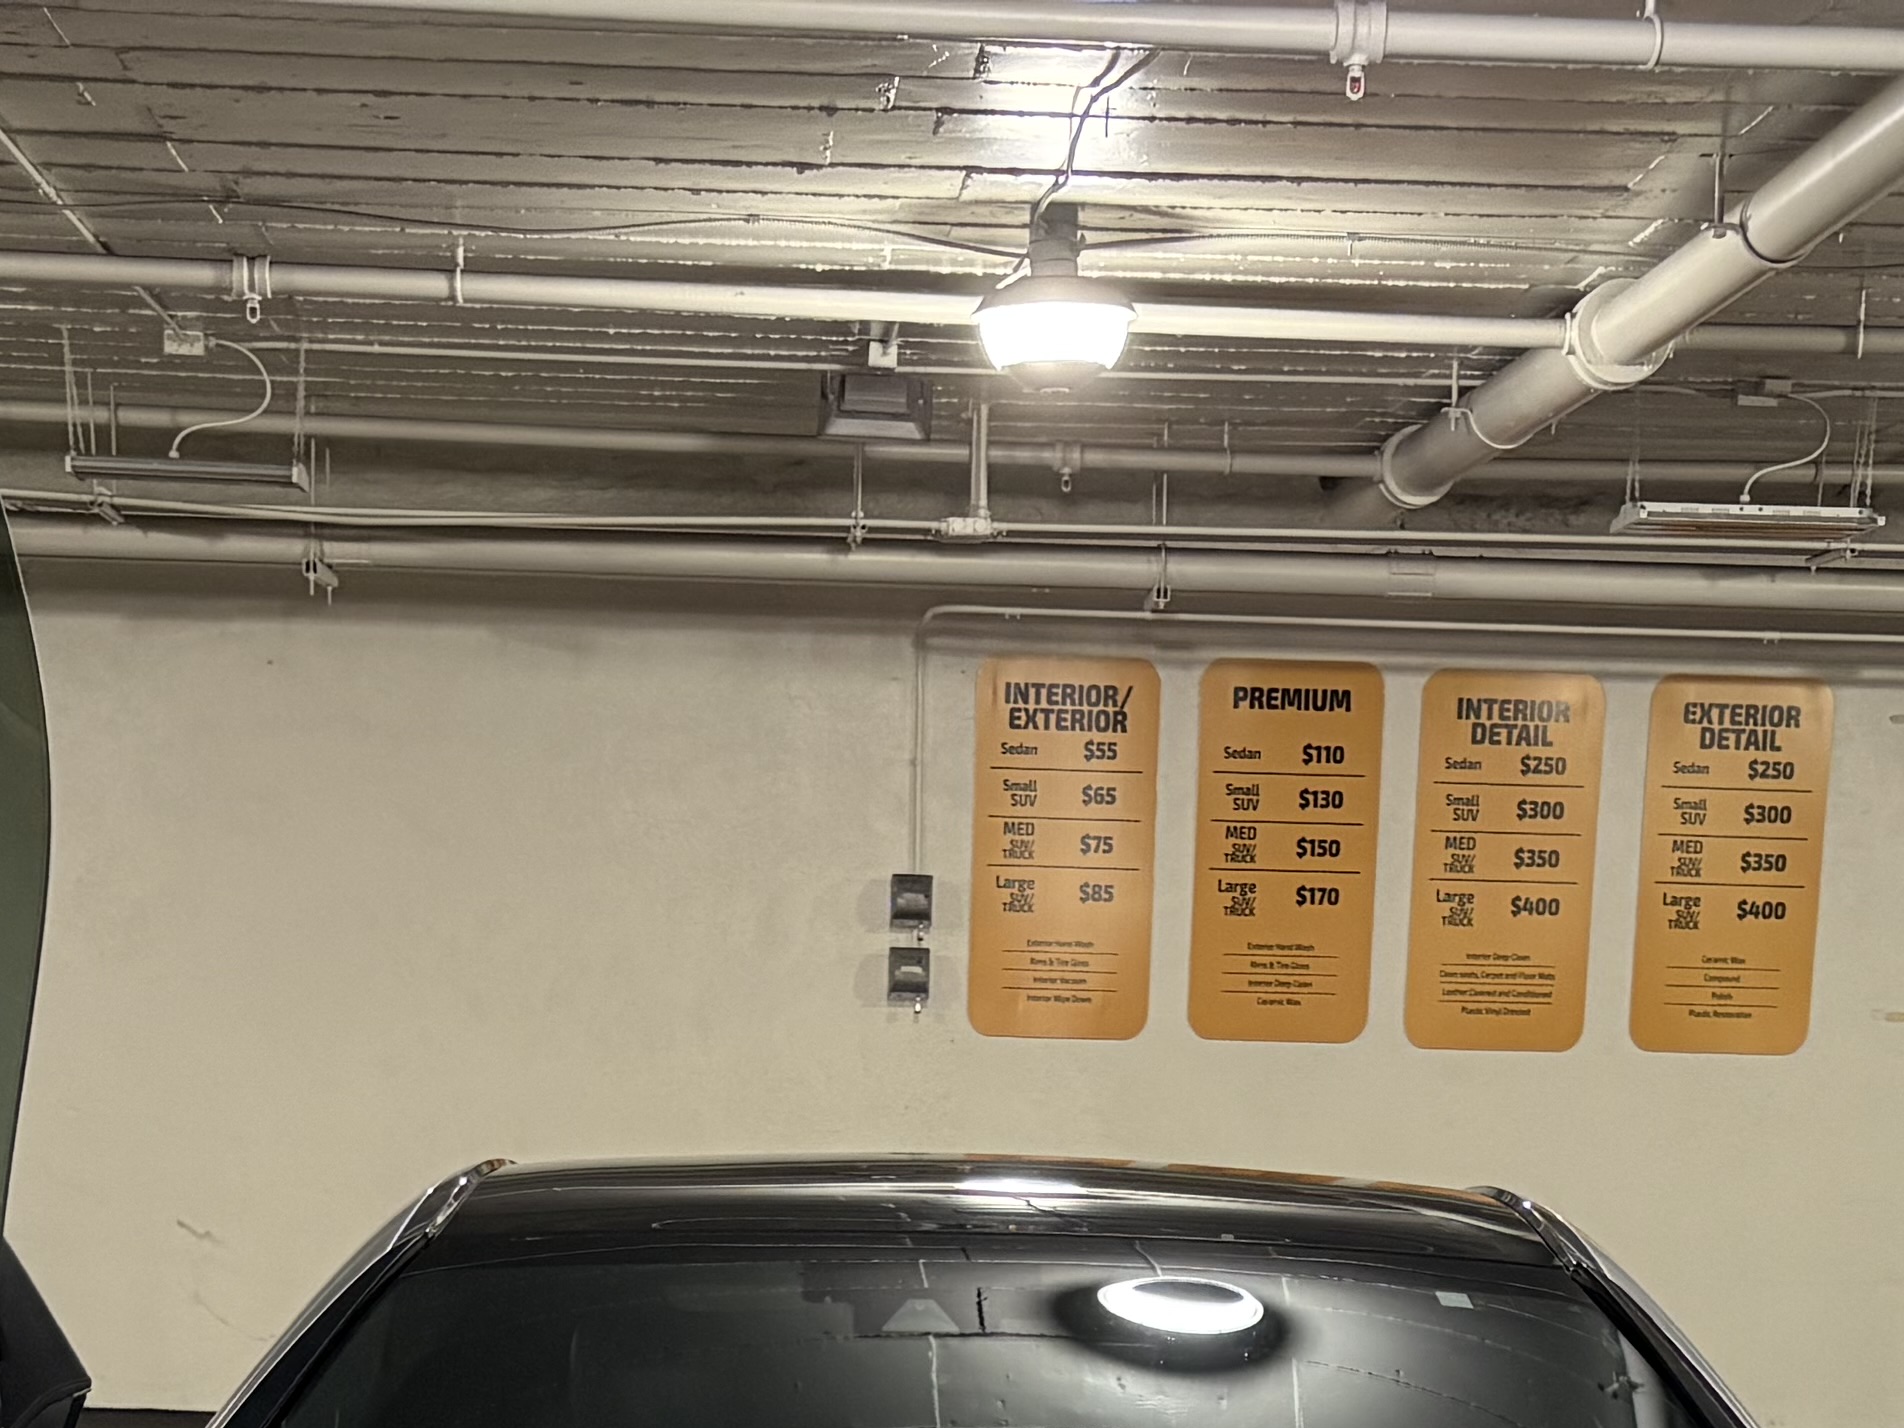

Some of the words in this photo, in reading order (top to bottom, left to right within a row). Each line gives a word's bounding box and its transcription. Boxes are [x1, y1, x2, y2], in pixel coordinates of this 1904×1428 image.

[1004, 682, 1133, 711] INTERIOR/
[1233, 686, 1352, 712] PREMIUM
[1008, 707, 1128, 733] EXTERIOR
[1456, 697, 1571, 723] INTERIOR
[1683, 702, 1801, 728] EXTERIOR
[1471, 722, 1553, 747] DETAIL
[1699, 727, 1782, 752] DETAIL
[1001, 742, 1038, 755] Sedan
[1084, 738, 1118, 762] $55
[1224, 746, 1261, 760] Sedan
[1302, 743, 1345, 766] $110
[1445, 757, 1482, 770] Sedan
[1520, 754, 1566, 777] $250
[1673, 761, 1710, 775] Sedan
[1748, 759, 1794, 781] $250
[1003, 779, 1037, 792] Small
[1082, 784, 1117, 807] $65
[1225, 784, 1260, 797] Small
[1010, 794, 1037, 807] SUV
[1233, 798, 1260, 811] SUV
[1299, 788, 1344, 811] $130
[1445, 794, 1480, 807] Small
[1516, 798, 1564, 821] $300
[1673, 798, 1707, 811] Small
[1453, 808, 1480, 822] SUV
[1680, 812, 1706, 826] SUV
[1743, 803, 1792, 825] $300
[1003, 822, 1035, 836] MED
[1225, 826, 1257, 840] MED
[1080, 833, 1114, 855] $75
[1296, 837, 1340, 859] $150
[1445, 836, 1476, 850] MED
[1672, 840, 1703, 854] MED
[1513, 847, 1560, 870] $350
[1740, 851, 1787, 873] $350
[996, 875, 1035, 892] Large
[1079, 882, 1114, 904] $85
[1217, 879, 1256, 896] Large
[1296, 885, 1339, 907] $170
[1436, 889, 1475, 906] Large
[1511, 895, 1560, 917] $400
[1663, 892, 1701, 909] Large
[1737, 899, 1786, 921] $400
